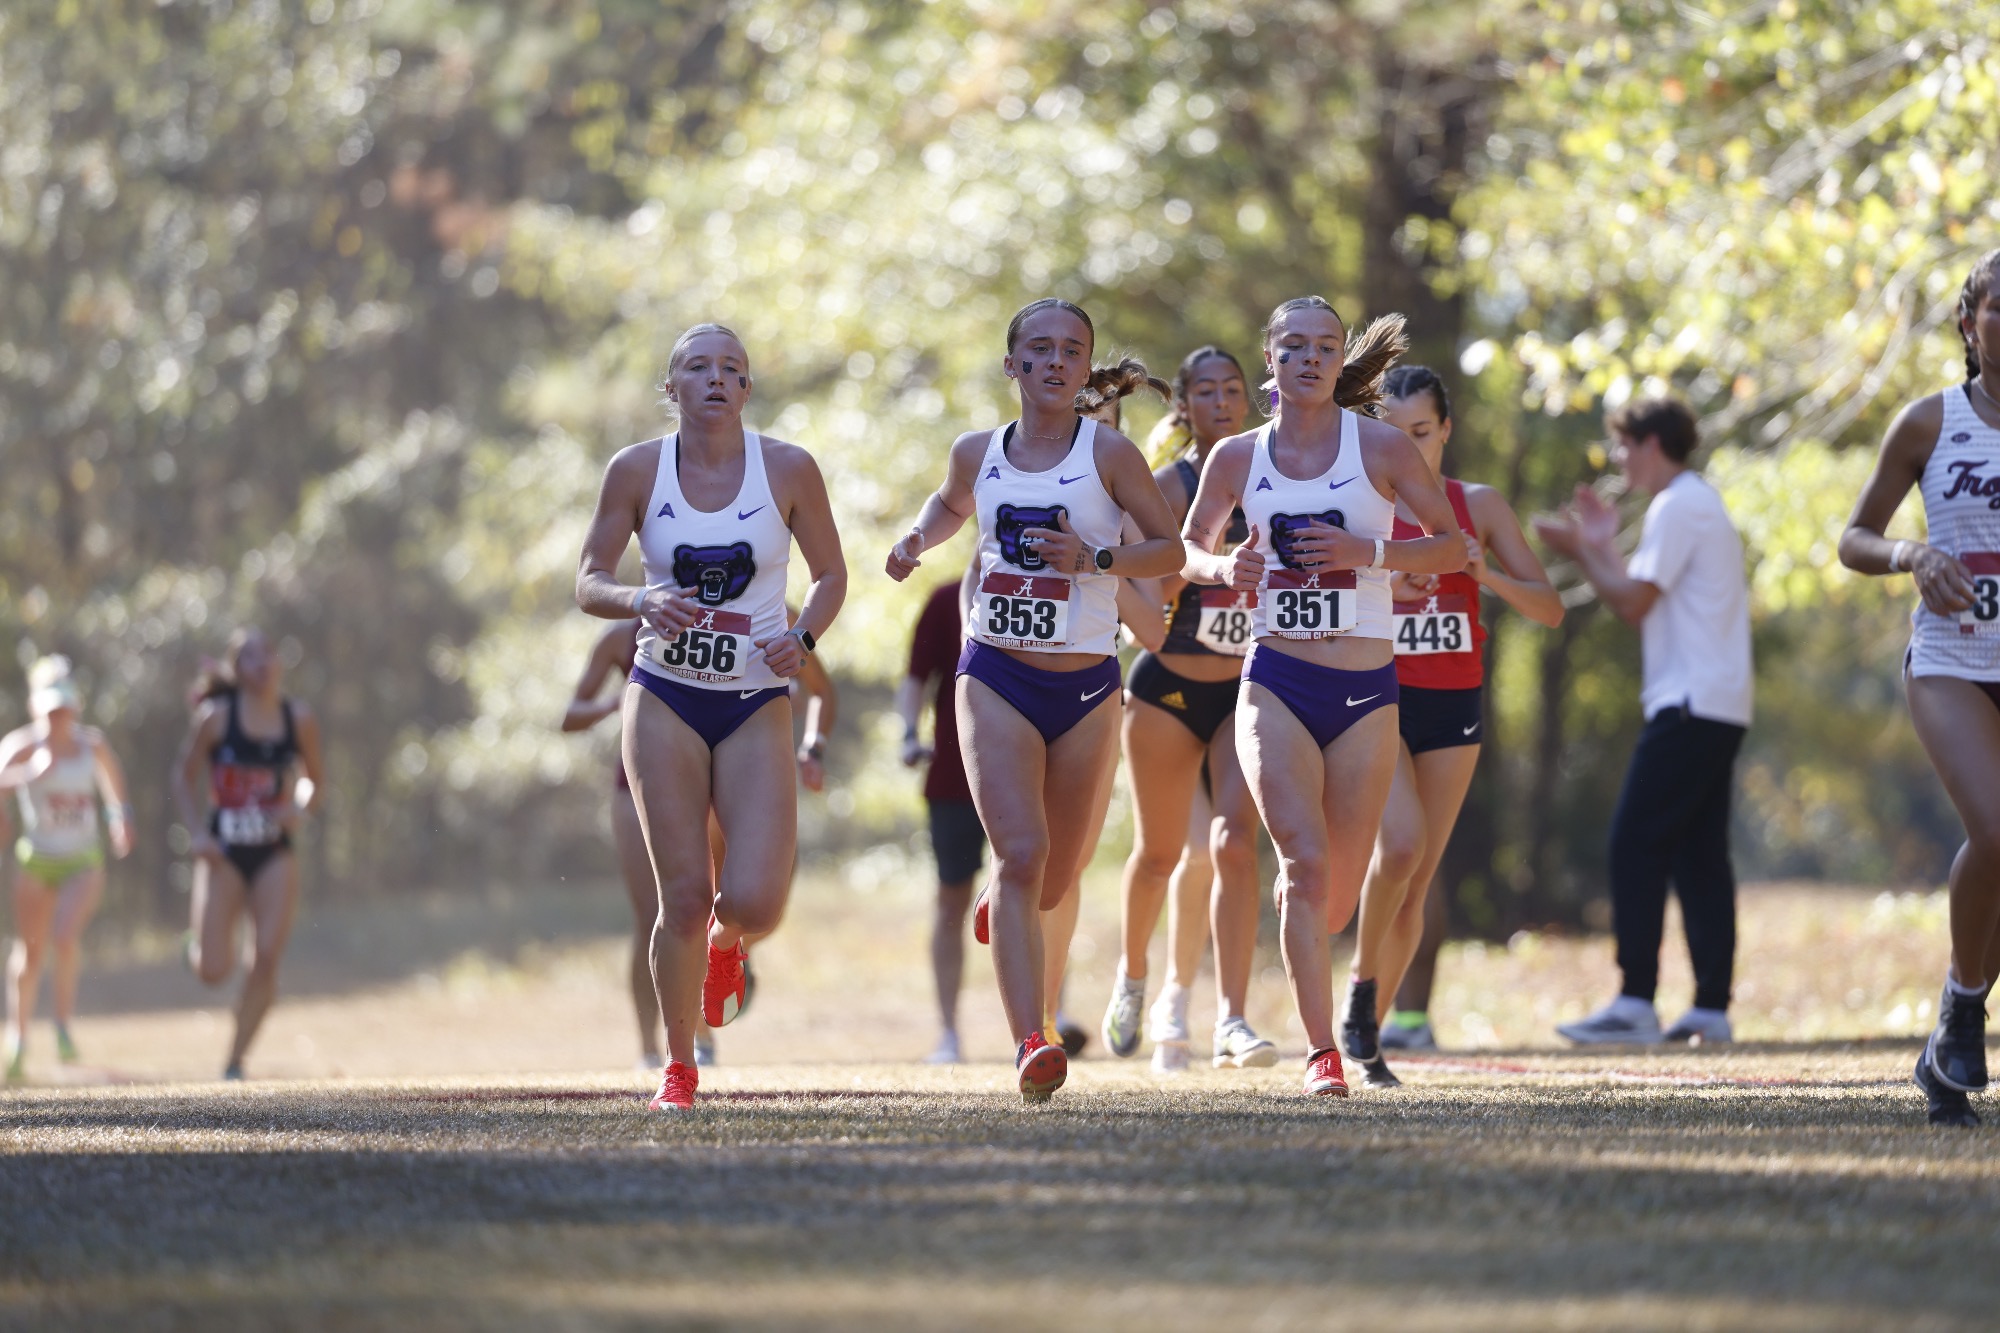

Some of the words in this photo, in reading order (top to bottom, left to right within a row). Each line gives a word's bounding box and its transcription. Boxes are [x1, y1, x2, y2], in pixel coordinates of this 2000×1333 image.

[1013, 578, 1033, 597] A
[694, 610, 715, 630] A
[989, 596, 1056, 640] 353
[1209, 611, 1250, 644] 48
[1277, 591, 1339, 629] 351
[1398, 615, 1462, 651] 443
[664, 630, 737, 673] 356
